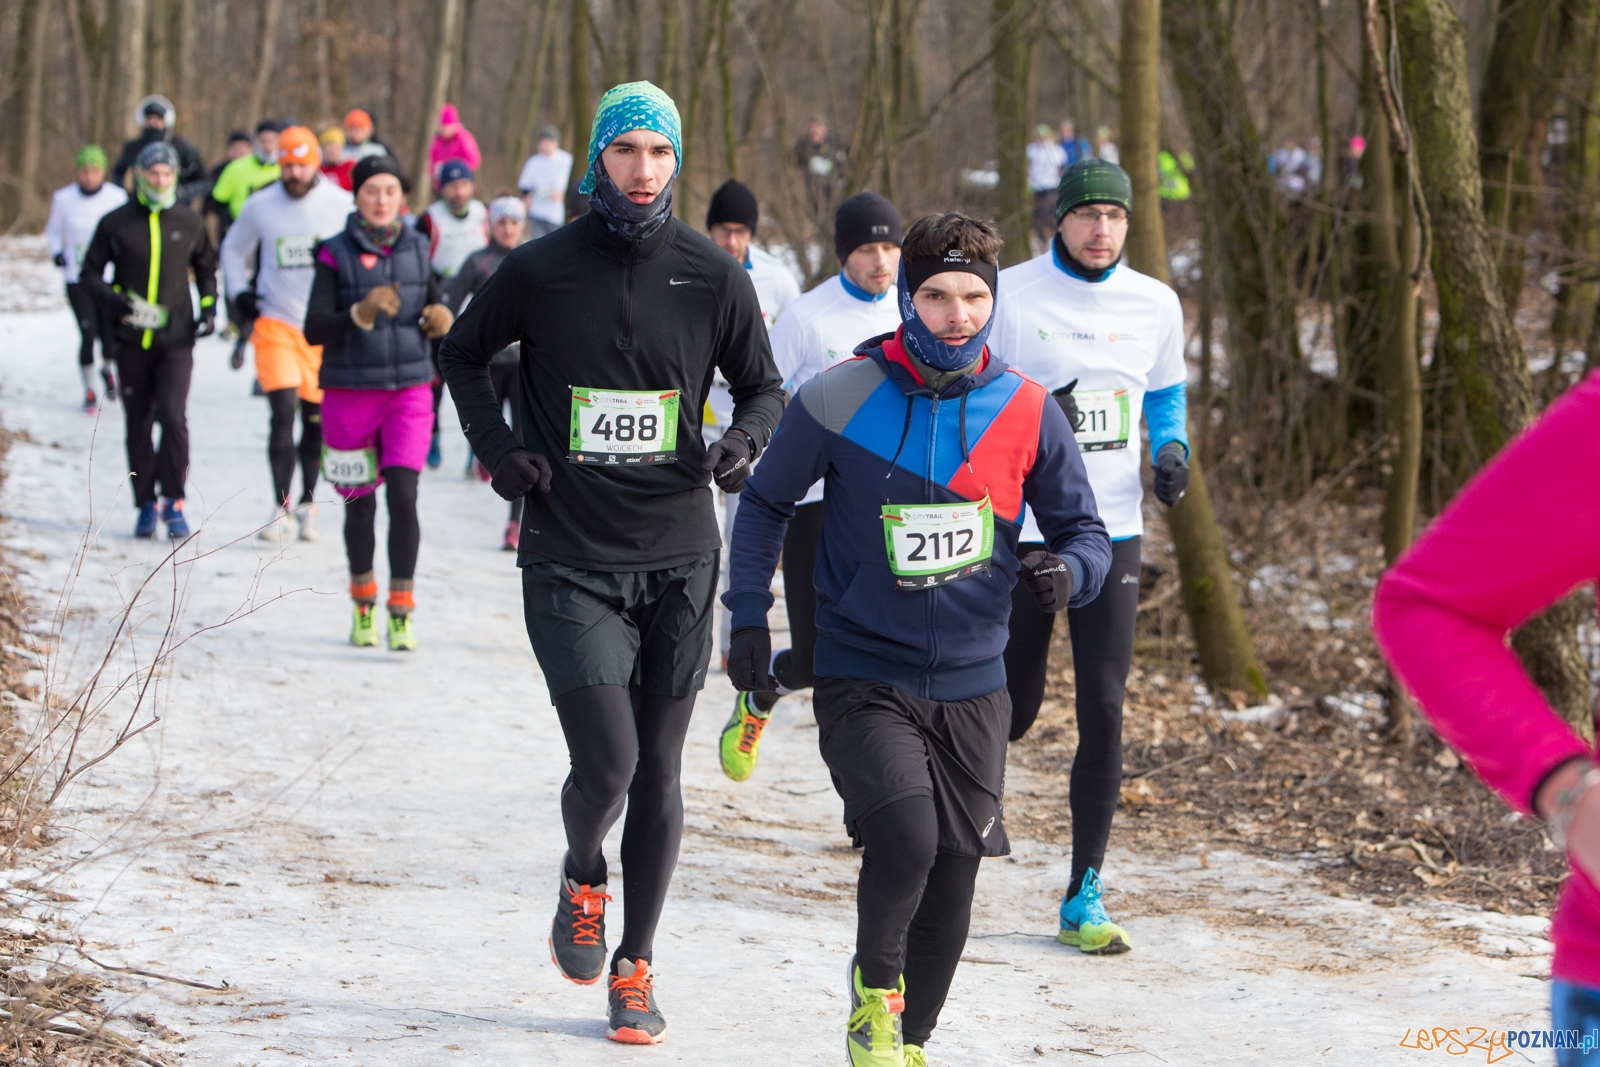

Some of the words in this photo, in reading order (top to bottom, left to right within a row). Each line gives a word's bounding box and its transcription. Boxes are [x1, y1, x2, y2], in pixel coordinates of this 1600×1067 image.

[591, 413, 658, 442] 488
[1076, 409, 1107, 433] 211
[606, 444, 643, 452] WOJCIECH
[330, 461, 364, 477] 289
[906, 528, 974, 562] 2112
